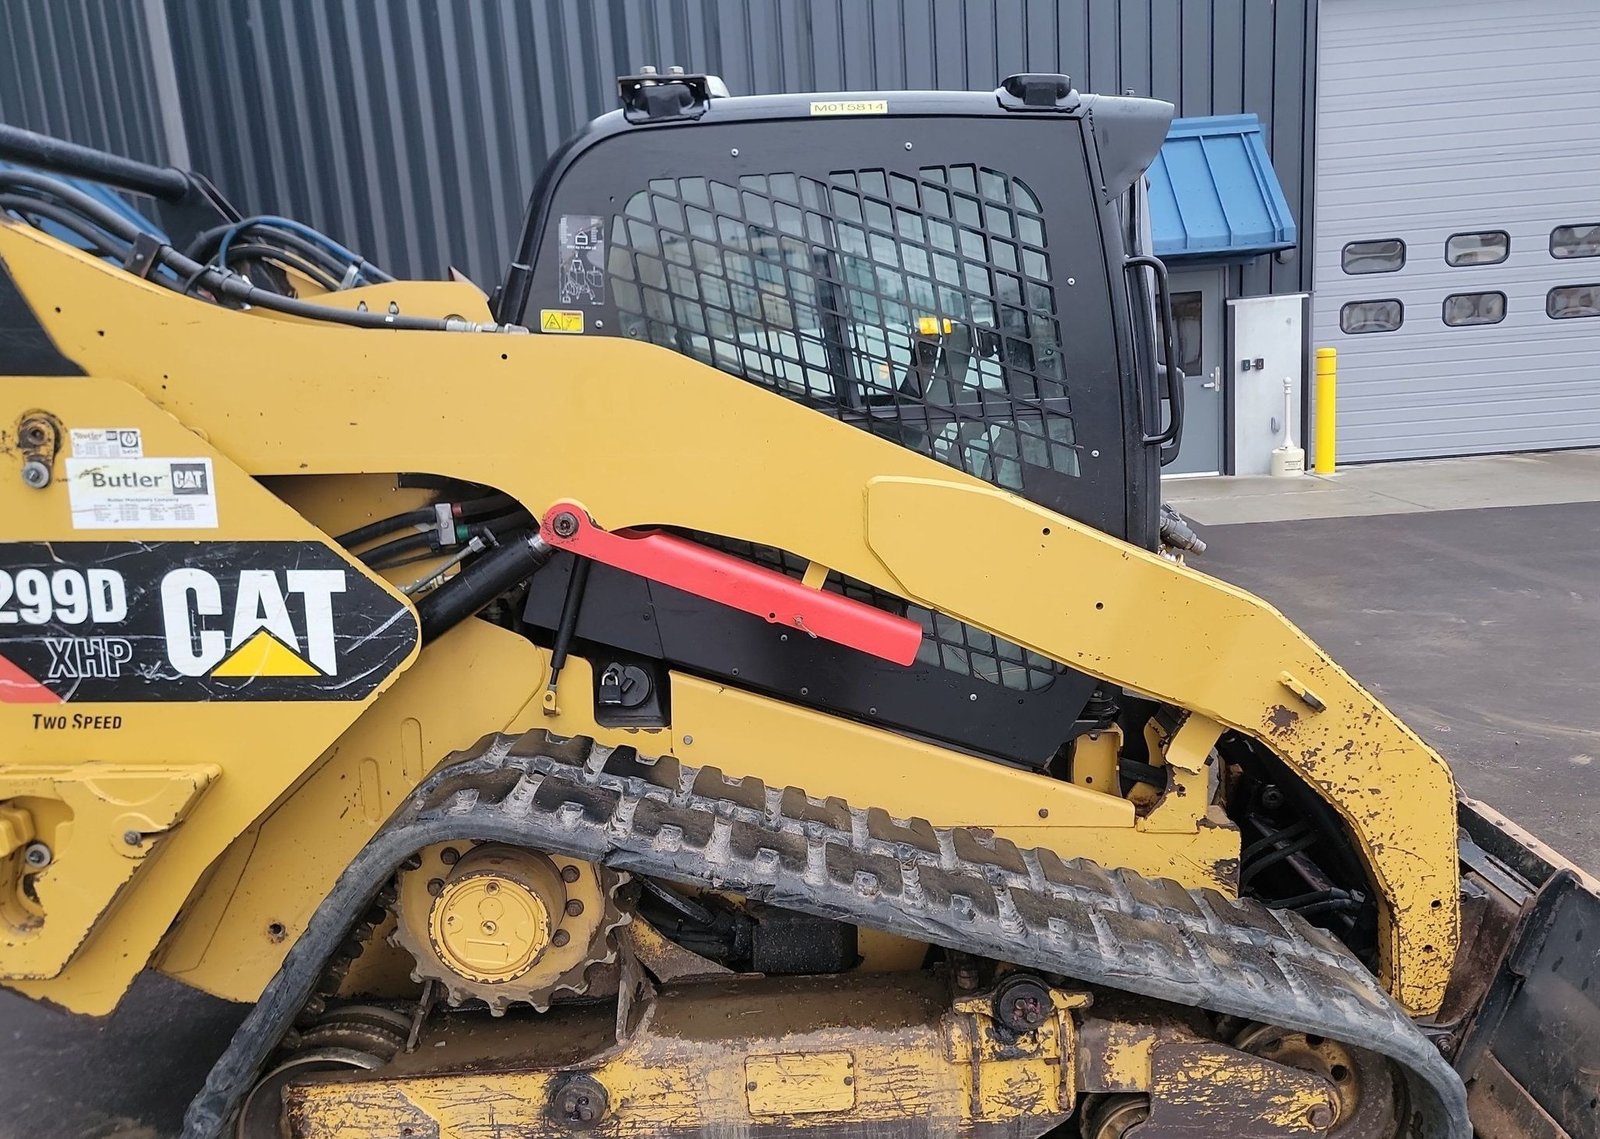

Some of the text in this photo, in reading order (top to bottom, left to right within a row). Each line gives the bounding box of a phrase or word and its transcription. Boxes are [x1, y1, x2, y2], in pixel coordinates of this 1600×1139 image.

[92, 470, 205, 489] Butler CAT
[160, 567, 347, 677] CAT
[44, 638, 133, 678] XHP
